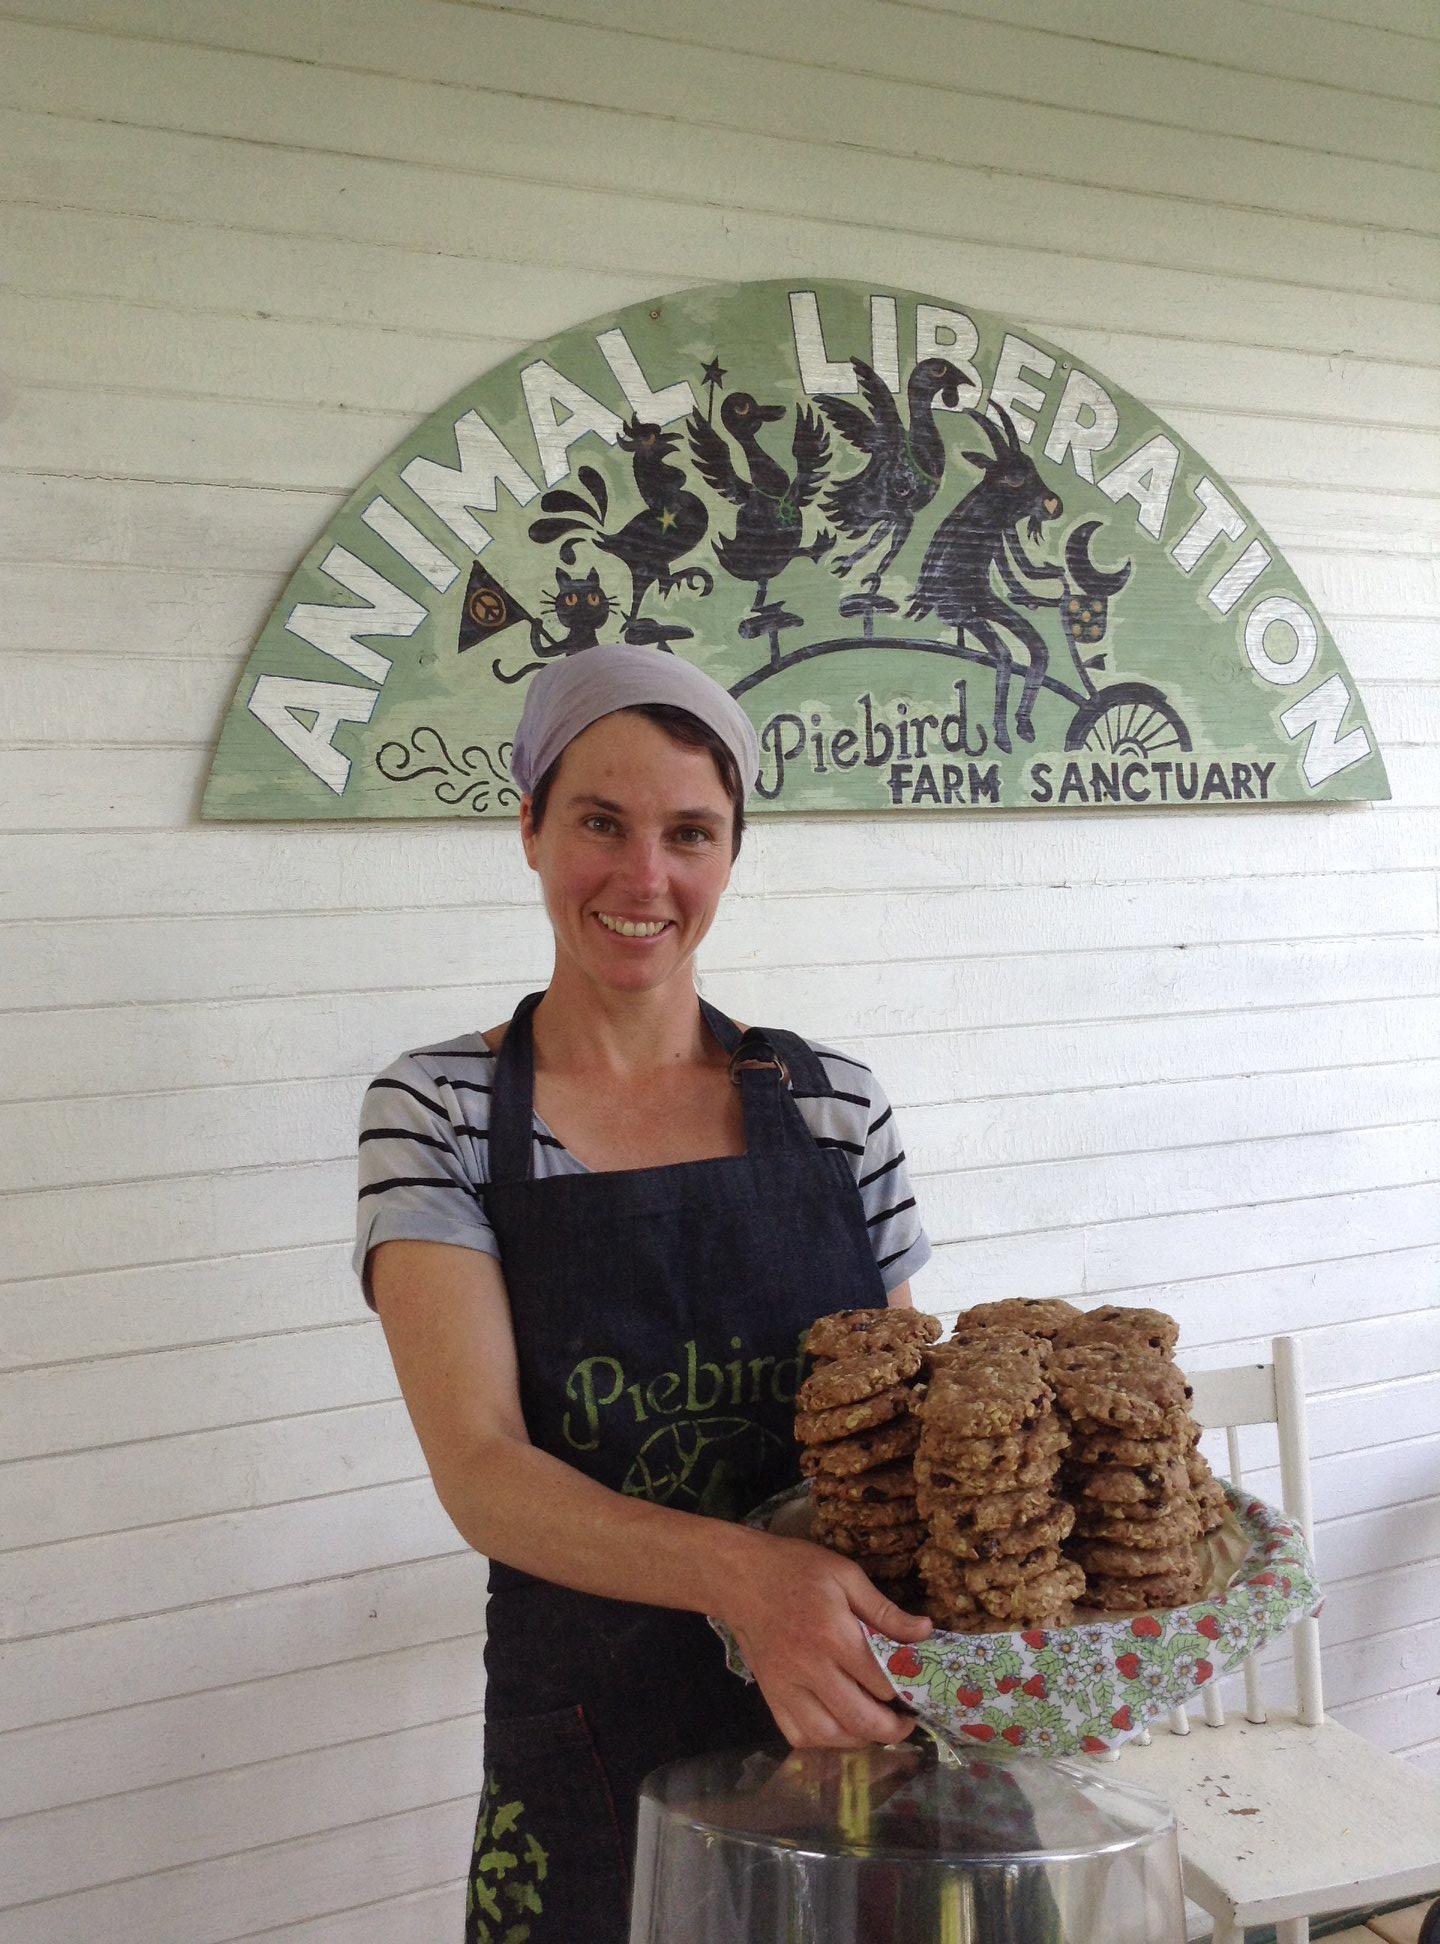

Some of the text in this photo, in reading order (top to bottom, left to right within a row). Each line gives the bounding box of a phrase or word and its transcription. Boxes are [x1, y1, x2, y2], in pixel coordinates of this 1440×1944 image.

[247, 290, 1373, 797] ANIMAL LIBERATION
[755, 680, 988, 800] Piebird
[887, 761, 1276, 804] FARM SANCTUARY
[562, 1330, 809, 1450] Piebird
